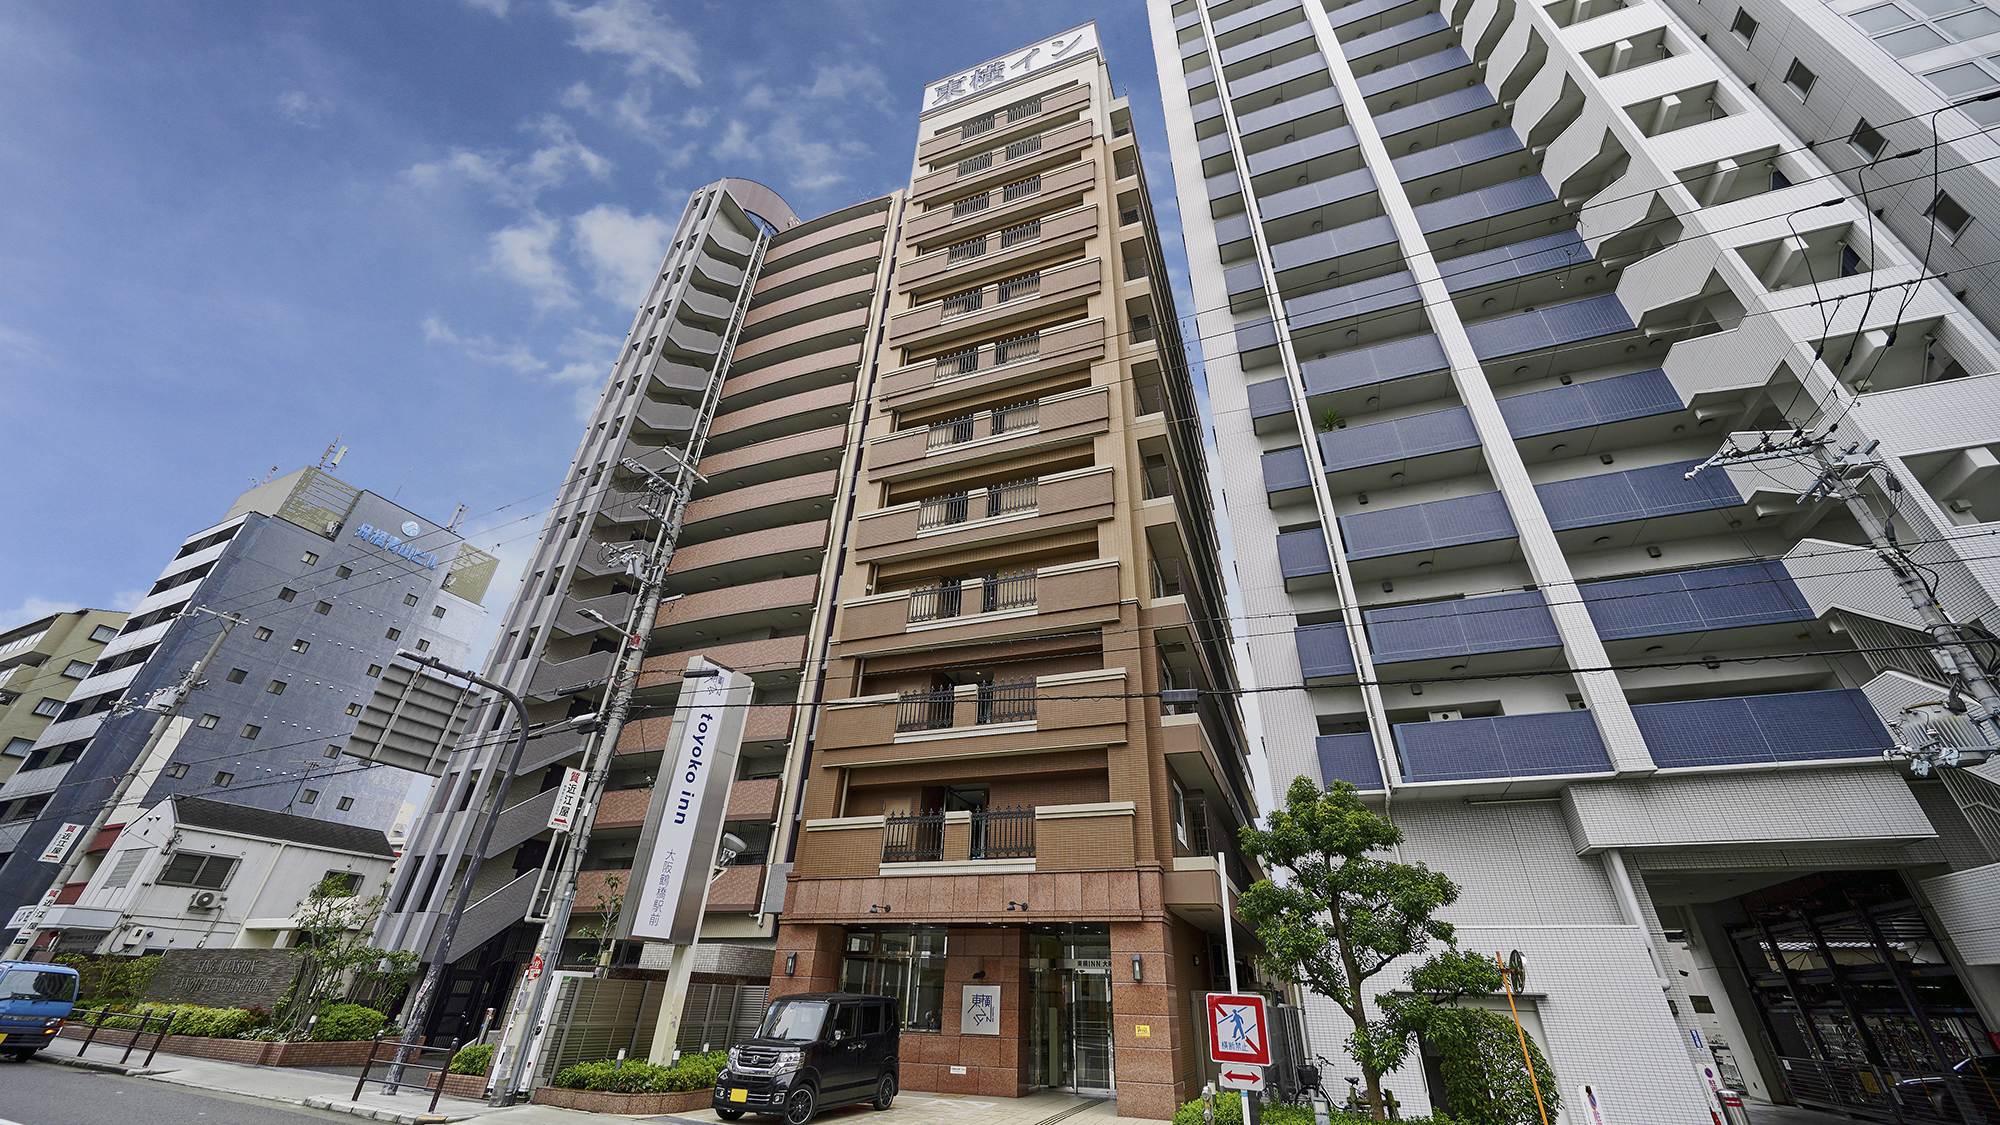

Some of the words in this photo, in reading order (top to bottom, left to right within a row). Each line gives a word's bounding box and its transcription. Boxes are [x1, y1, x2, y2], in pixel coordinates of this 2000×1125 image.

[932, 34, 1082, 106] 東横イン
[685, 713, 713, 783] toyoko
[674, 790, 695, 825] inn
[649, 849, 676, 926] 大阪鶴橋駅前
